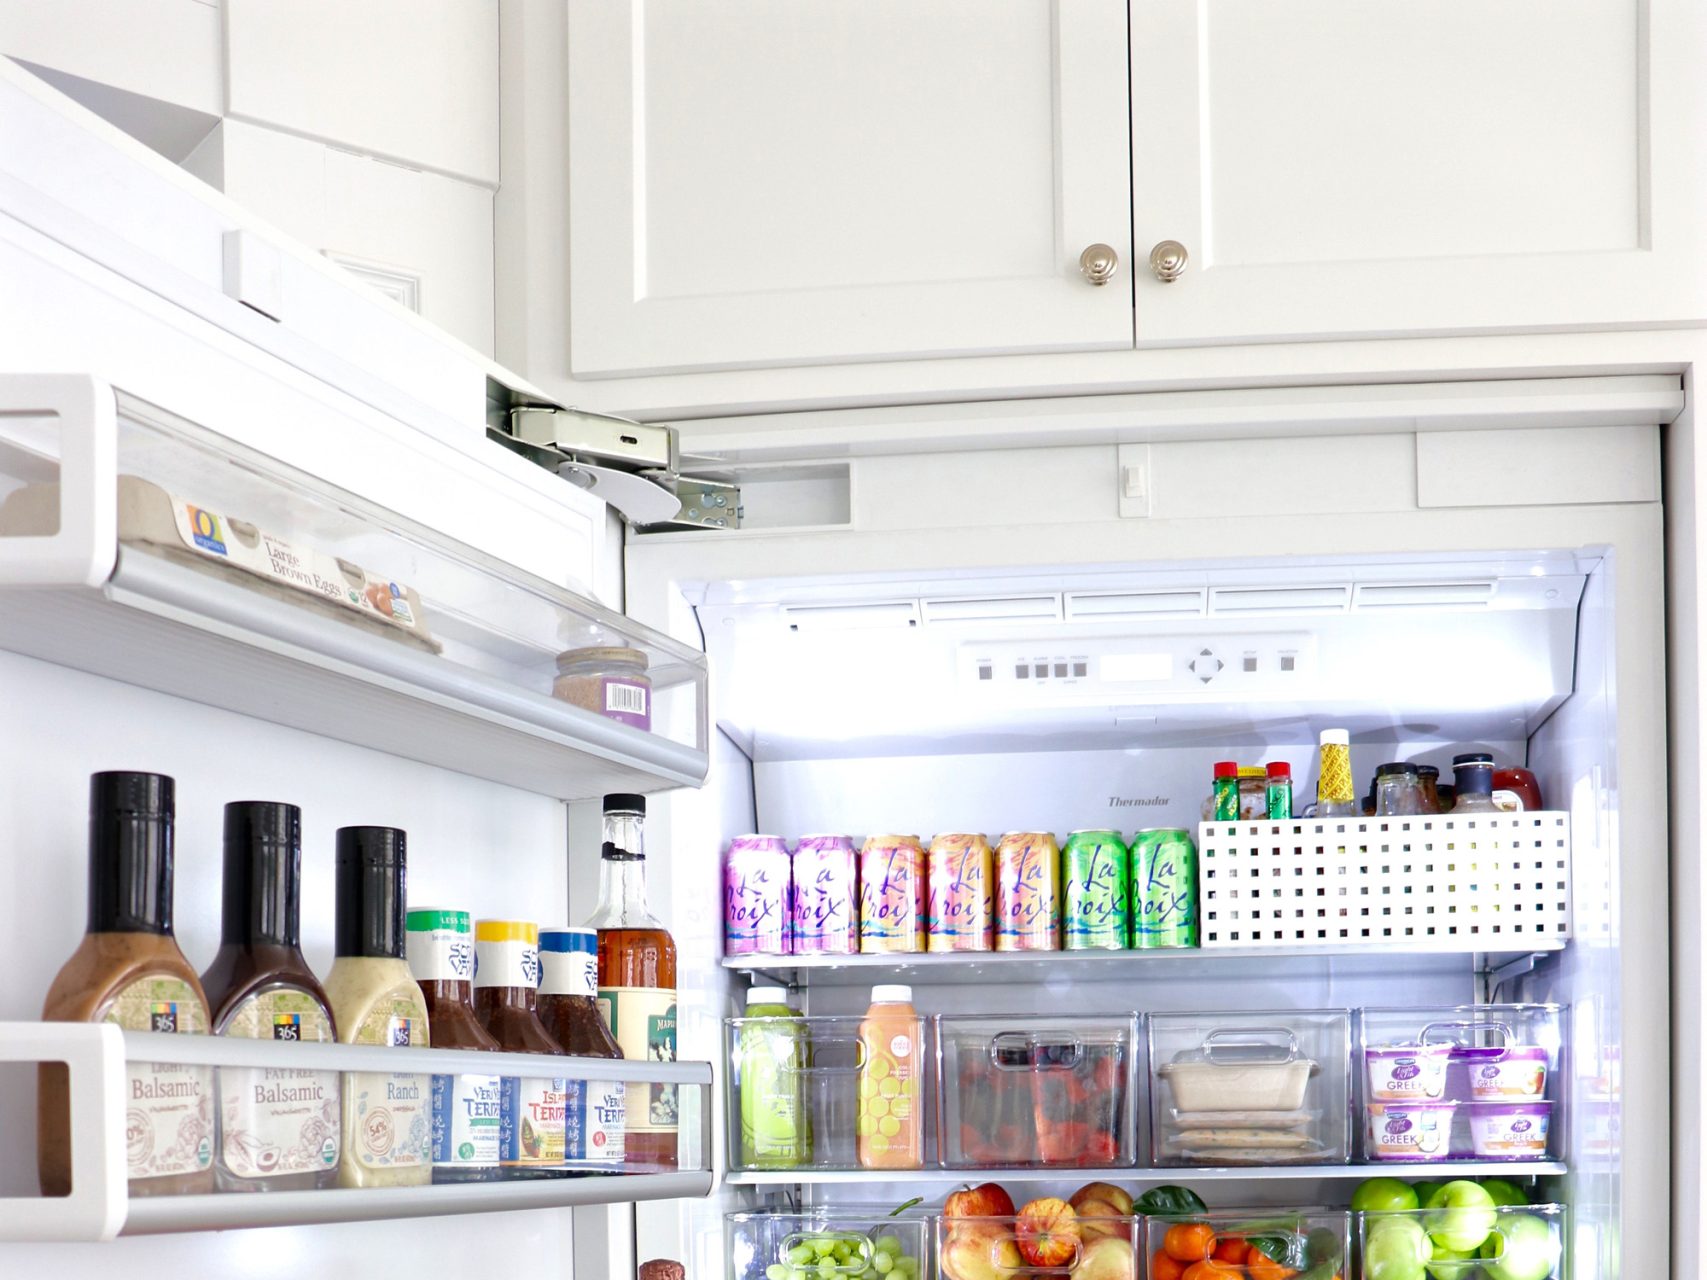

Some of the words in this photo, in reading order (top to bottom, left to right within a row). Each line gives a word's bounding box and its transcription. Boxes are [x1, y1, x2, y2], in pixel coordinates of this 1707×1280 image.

[265, 541, 300, 567] Large
[270, 557, 311, 586] Brown
[313, 572, 342, 599] Eggs
[1108, 796, 1170, 808] Thermador
[880, 848, 911, 896] La
[950, 846, 983, 894] La
[1012, 845, 1043, 893] La
[1082, 844, 1117, 892] La
[1147, 843, 1183, 892] La
[154, 1014, 175, 1032] 365
[277, 1025, 298, 1041] 365
[395, 1030, 409, 1044] 365
[264, 1068, 285, 1081] FAT
[287, 1068, 315, 1080] FREE
[132, 1077, 200, 1100] Balsamic
[255, 1081, 324, 1105] Balsamic
[387, 1081, 419, 1100] Ranch
[1387, 1081, 1422, 1090] GREE
[1381, 1135, 1417, 1144] GREEK
[1503, 1133, 1536, 1141] GREEK
